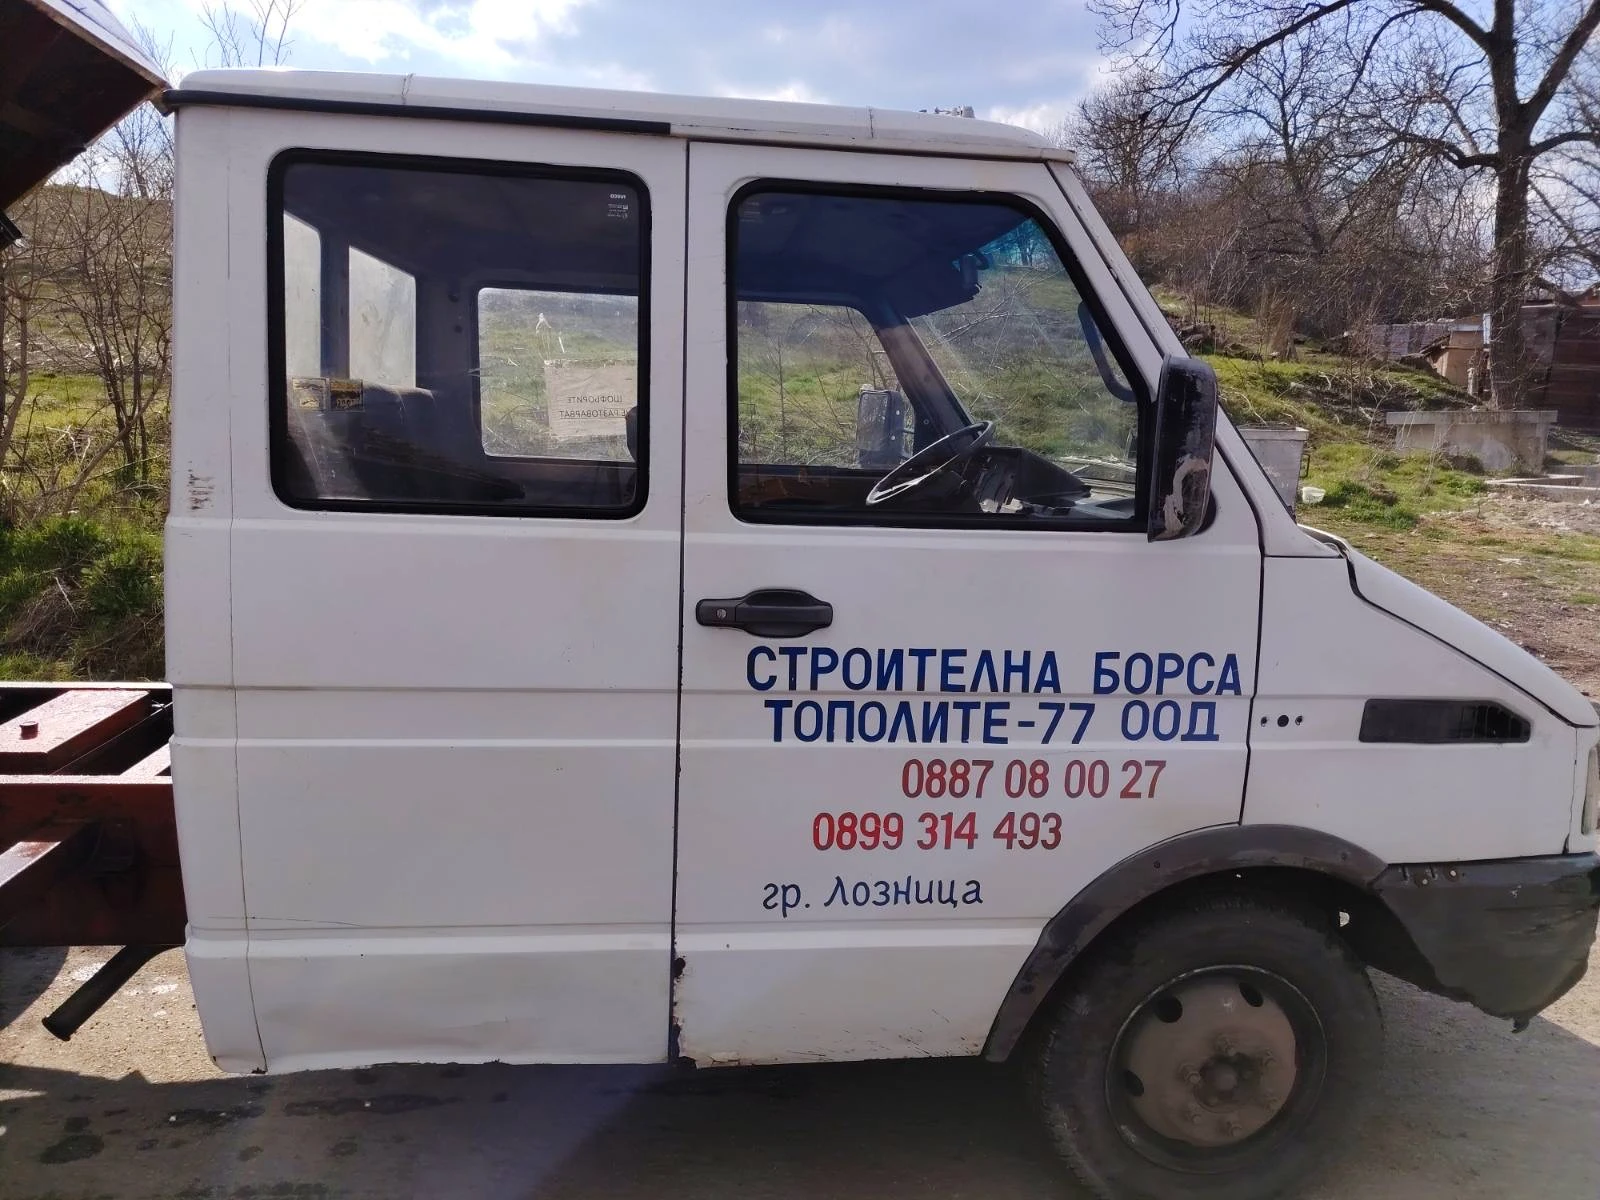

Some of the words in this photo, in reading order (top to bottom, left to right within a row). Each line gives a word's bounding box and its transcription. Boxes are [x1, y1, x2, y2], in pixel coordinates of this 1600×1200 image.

[746, 646, 1062, 694] СТРОИТЕЛНА
[1093, 652, 1242, 695] БОРСА
[764, 699, 1096, 744] ТОПОЛИТЕ-77
[1121, 699, 1220, 742] ООД
[902, 759, 995, 799] 0887
[1005, 760, 1050, 798] 08
[1065, 760, 1110, 798] 00
[1120, 760, 1167, 799] 27
[813, 812, 904, 851] 0899
[917, 812, 979, 850] 314
[993, 812, 1063, 850] 493
[762, 883, 811, 918] гр.
